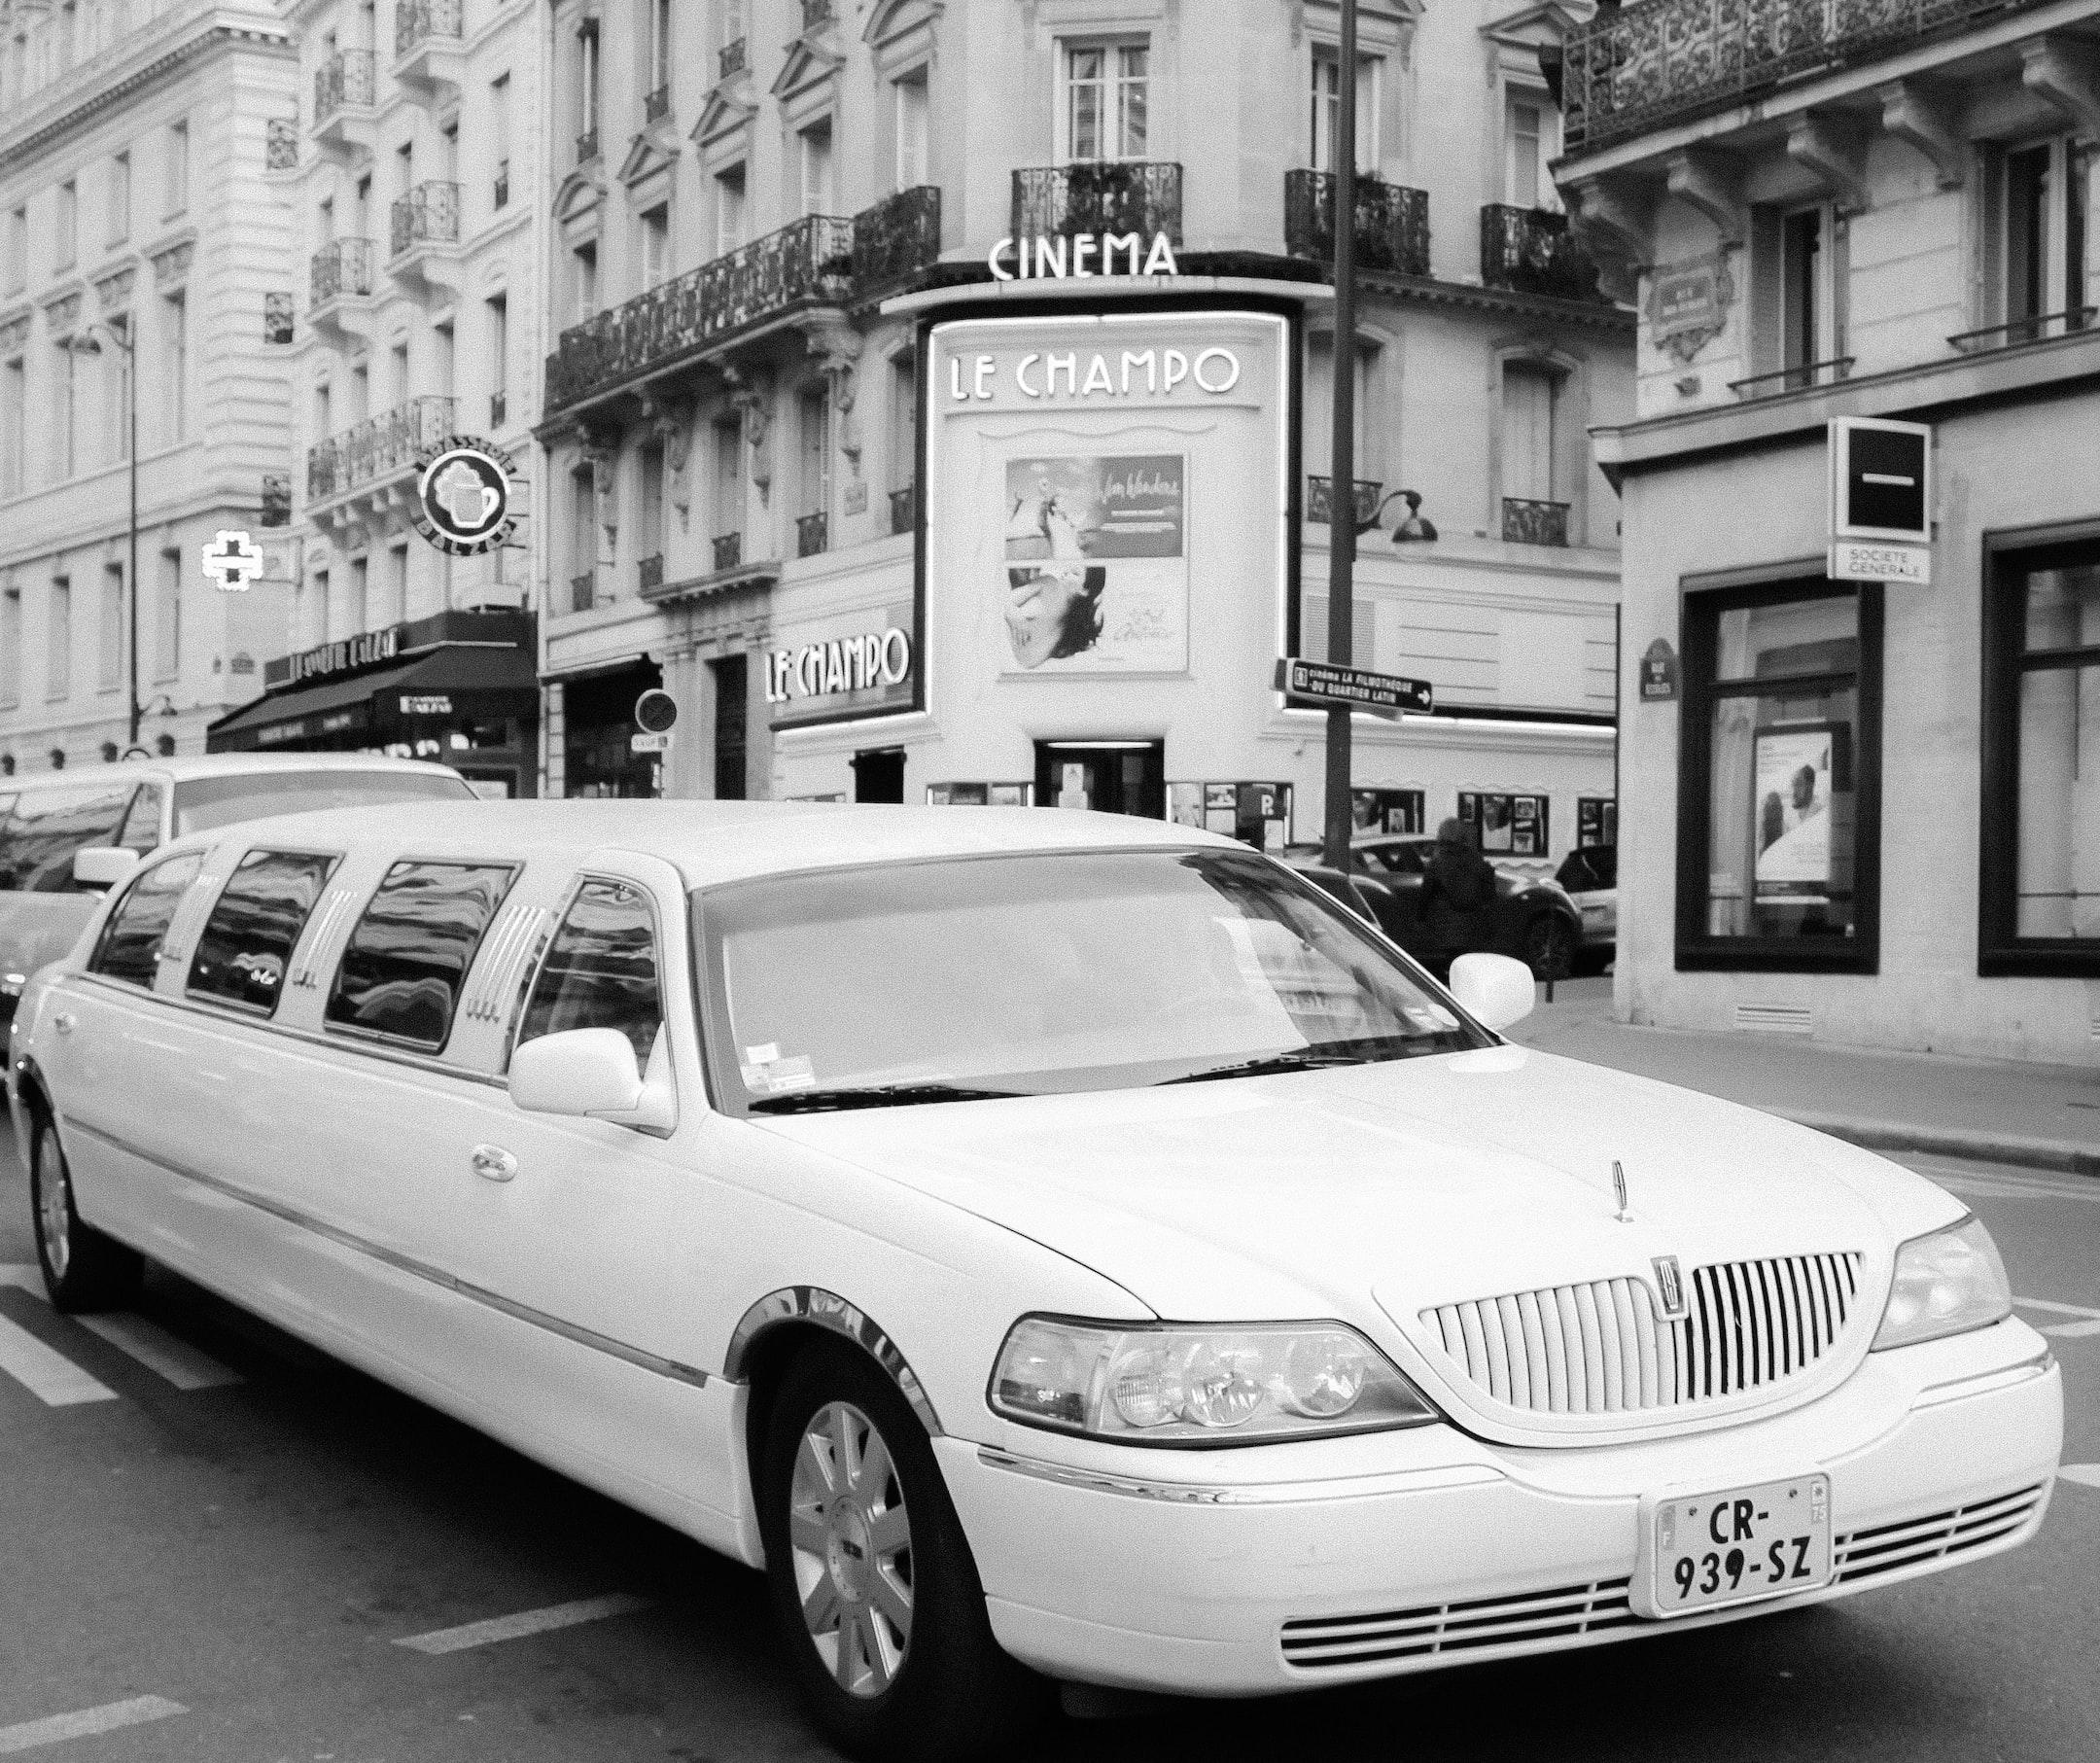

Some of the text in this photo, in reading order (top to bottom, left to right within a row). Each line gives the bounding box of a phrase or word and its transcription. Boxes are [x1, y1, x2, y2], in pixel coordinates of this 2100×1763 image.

[988, 230, 1179, 280] CINEMA
[950, 347, 1240, 400] LE CHAMPO
[415, 519, 517, 556] BALZAR
[765, 628, 910, 703] LE CHAMPO
[1342, 672, 1353, 684] LA
[1327, 683, 1370, 699] QUARTIER
[1372, 689, 1396, 703] LATIN
[1709, 1499, 1769, 1545] CR-
[1674, 1536, 1811, 1599] 939-SZ
